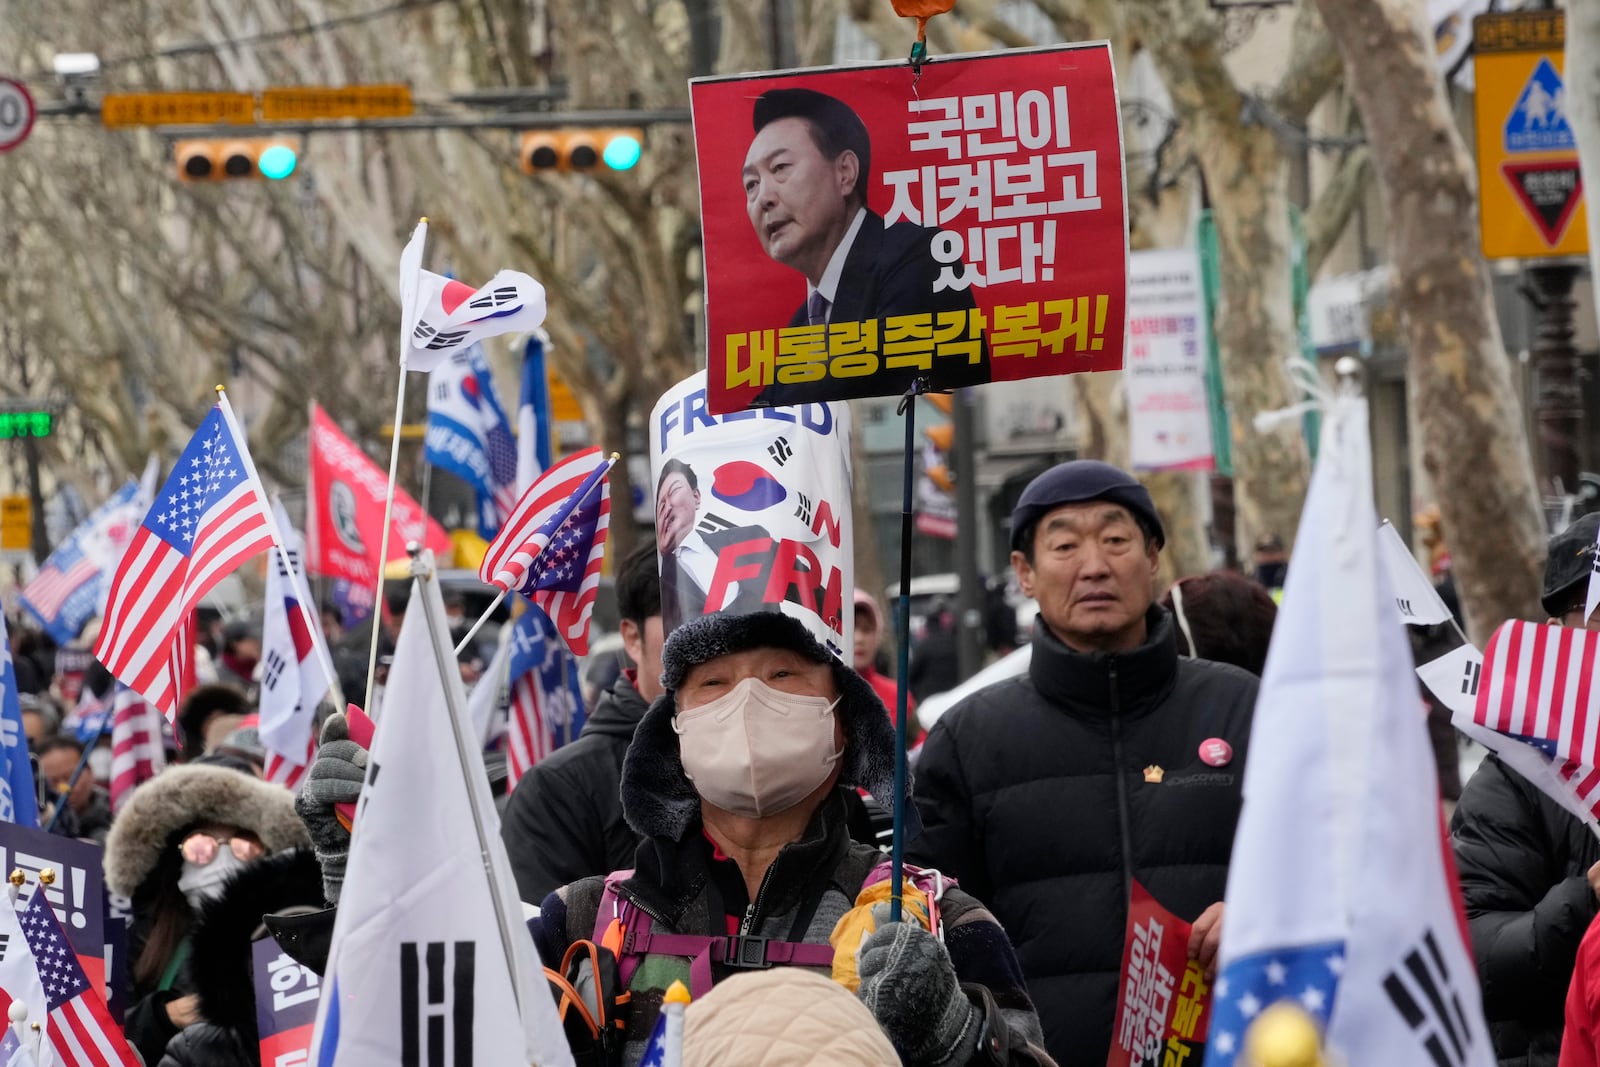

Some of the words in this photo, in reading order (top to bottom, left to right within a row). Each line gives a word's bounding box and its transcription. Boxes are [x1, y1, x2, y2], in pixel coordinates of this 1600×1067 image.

[0, 95, 20, 130] 0
[907, 85, 1070, 160] 국민이
[883, 150, 1102, 229] 지켜보고
[930, 220, 1056, 293] 있다!
[725, 318, 879, 390] 대통령
[884, 306, 988, 370] 즉각
[990, 294, 1109, 357] 복귀!
[1119, 921, 1148, 1052] 국민이
[1129, 915, 1164, 1067] 지켜보고
[1144, 962, 1175, 1067] 있다!
[1162, 1035, 1191, 1067] 각
